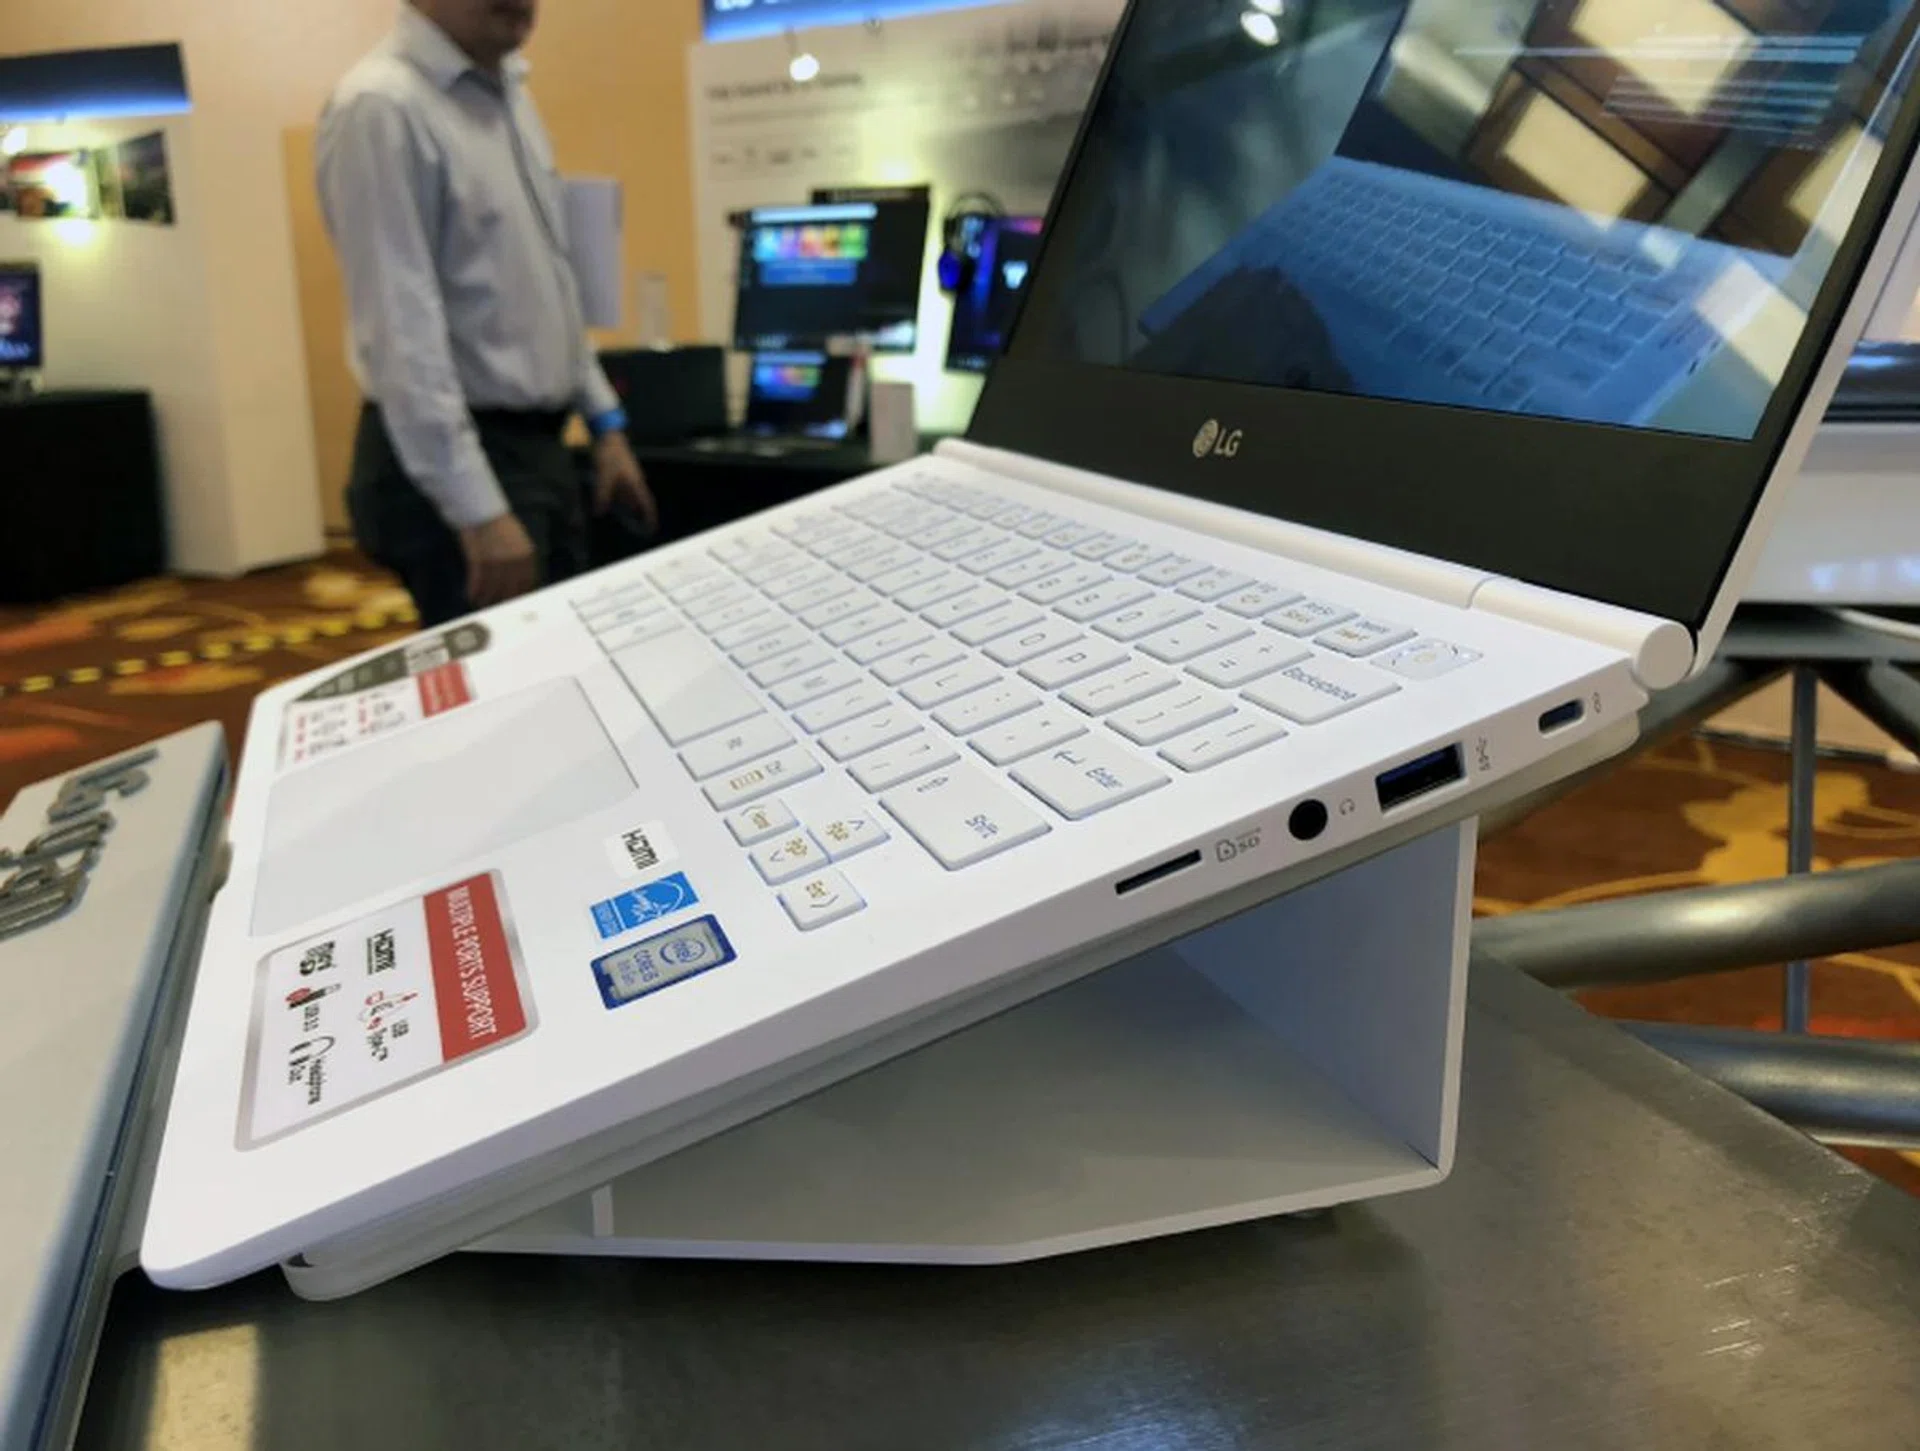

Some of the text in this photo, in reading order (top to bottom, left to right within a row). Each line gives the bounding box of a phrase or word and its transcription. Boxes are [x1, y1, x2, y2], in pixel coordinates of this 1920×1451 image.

[1214, 428, 1243, 457] LG
[455, 932, 485, 979] PORTS
[460, 973, 498, 1041] SUPPORT
